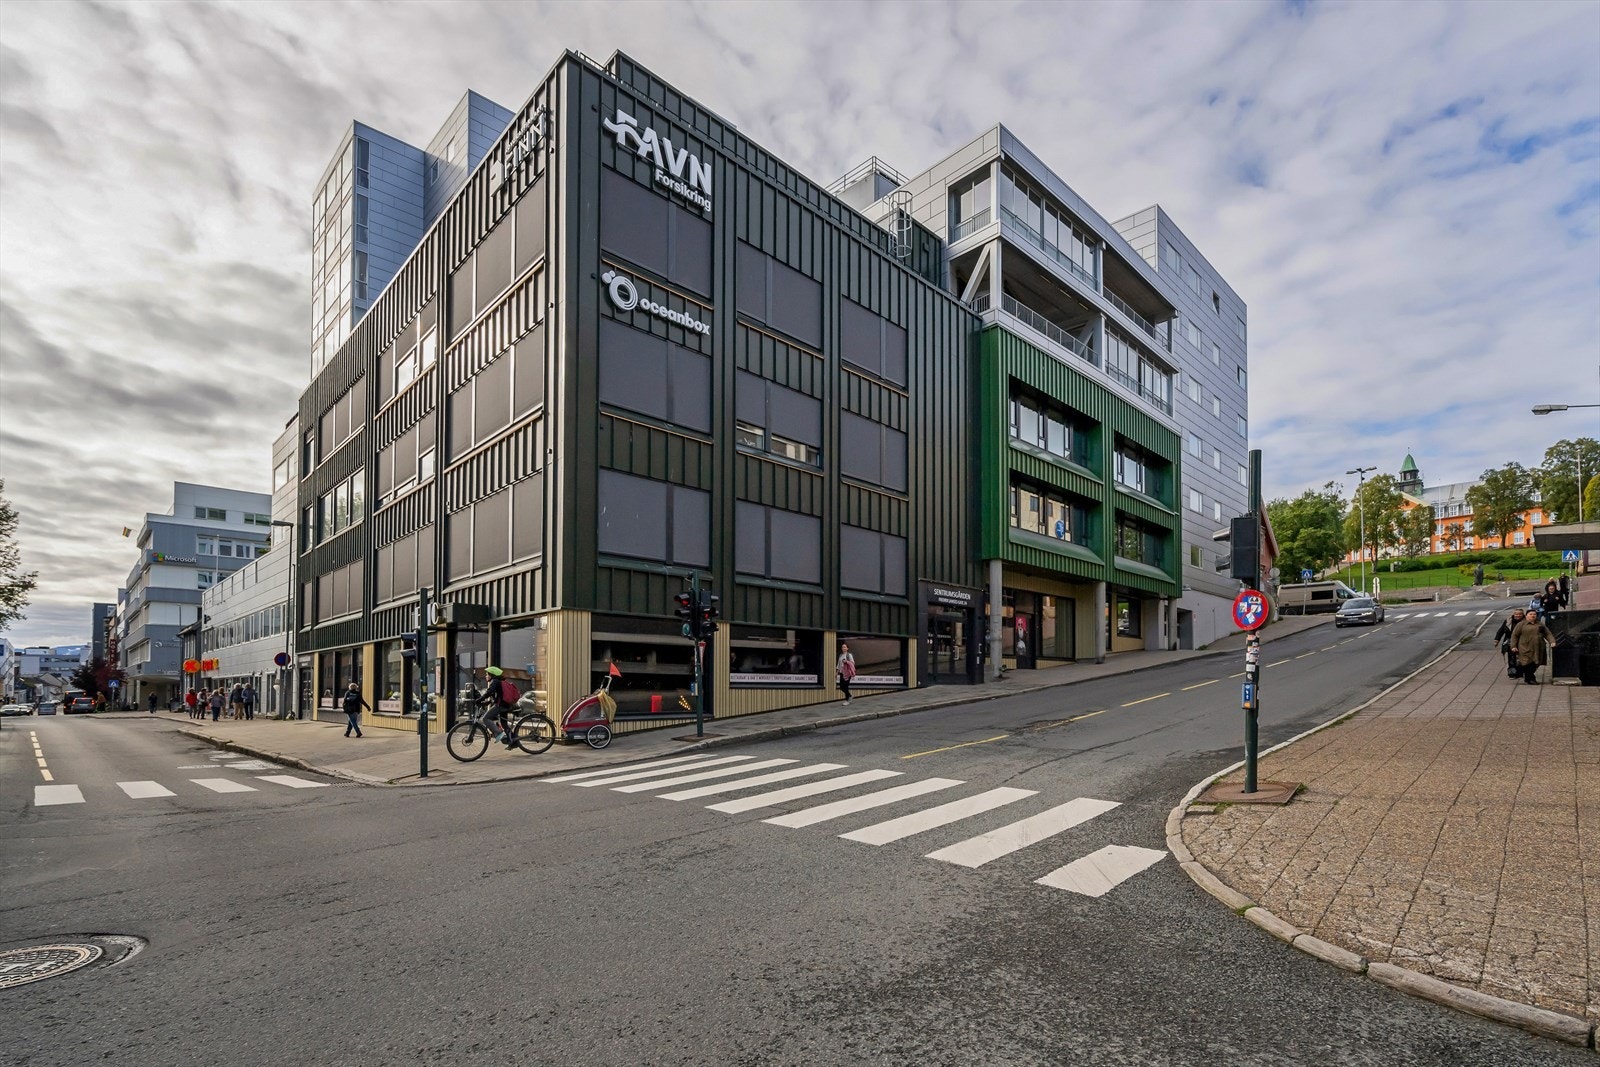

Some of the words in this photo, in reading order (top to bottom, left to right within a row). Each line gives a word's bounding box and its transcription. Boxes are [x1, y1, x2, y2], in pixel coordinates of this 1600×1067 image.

[603, 108, 712, 196] FAVN
[655, 168, 712, 212] Forsikring
[640, 298, 710, 336] oceanbox
[164, 555, 197, 563] Microsoft
